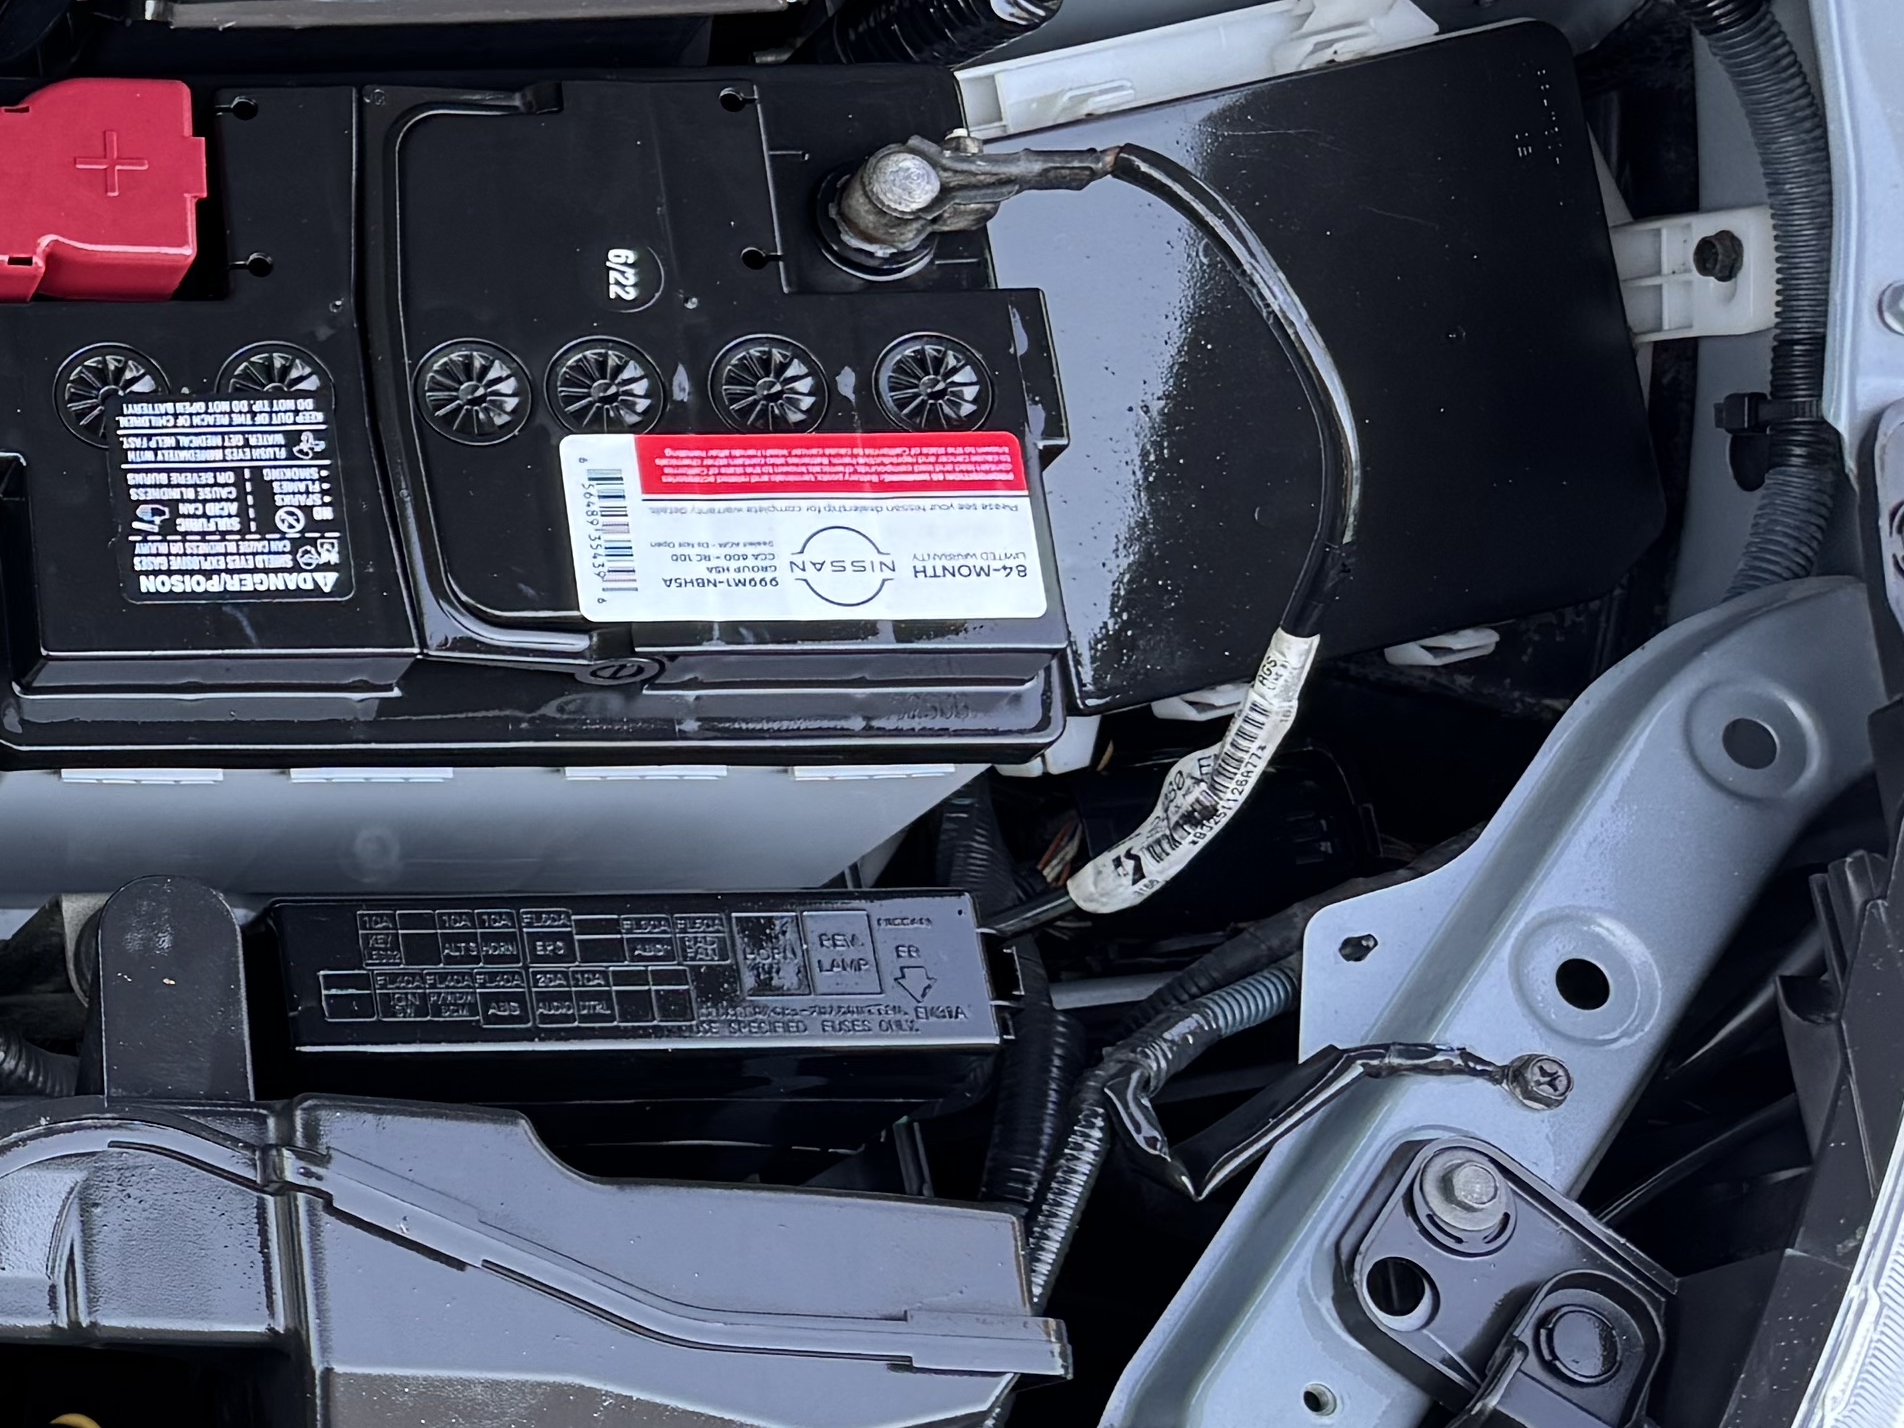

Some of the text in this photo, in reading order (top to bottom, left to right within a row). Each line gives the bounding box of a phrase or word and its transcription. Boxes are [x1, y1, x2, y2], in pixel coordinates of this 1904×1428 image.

[606, 248, 637, 301] 6/22
[175, 402, 205, 414] OPEN
[175, 415, 190, 426] OF
[192, 414, 228, 425] REACH
[230, 413, 253, 424] THE
[255, 413, 269, 424] OF
[271, 412, 294, 423] OUT
[149, 436, 175, 447] HELP
[170, 472, 214, 484] SEVERE
[216, 471, 234, 483] OR
[263, 467, 319, 480] SMOKING
[273, 480, 320, 493] FLAMES
[197, 486, 236, 500] CAUSE
[179, 501, 238, 515] ACID CAN
[650, 540, 675, 548] Open
[671, 554, 693, 562] 100
[752, 553, 775, 561] CCA
[734, 565, 777, 573] GROUP
[789, 559, 896, 572] NISSAN
[913, 564, 1027, 579] 84-MONTH
[138, 572, 313, 593] DANGER/POISON
[363, 916, 392, 929] 10A
[442, 915, 471, 928] 10A
[482, 915, 512, 927] 10A
[482, 942, 517, 955] HORN
[817, 958, 870, 972] LAMP
[730, 1020, 808, 1035] SPECIFIED
[821, 1020, 873, 1034] FUSES
